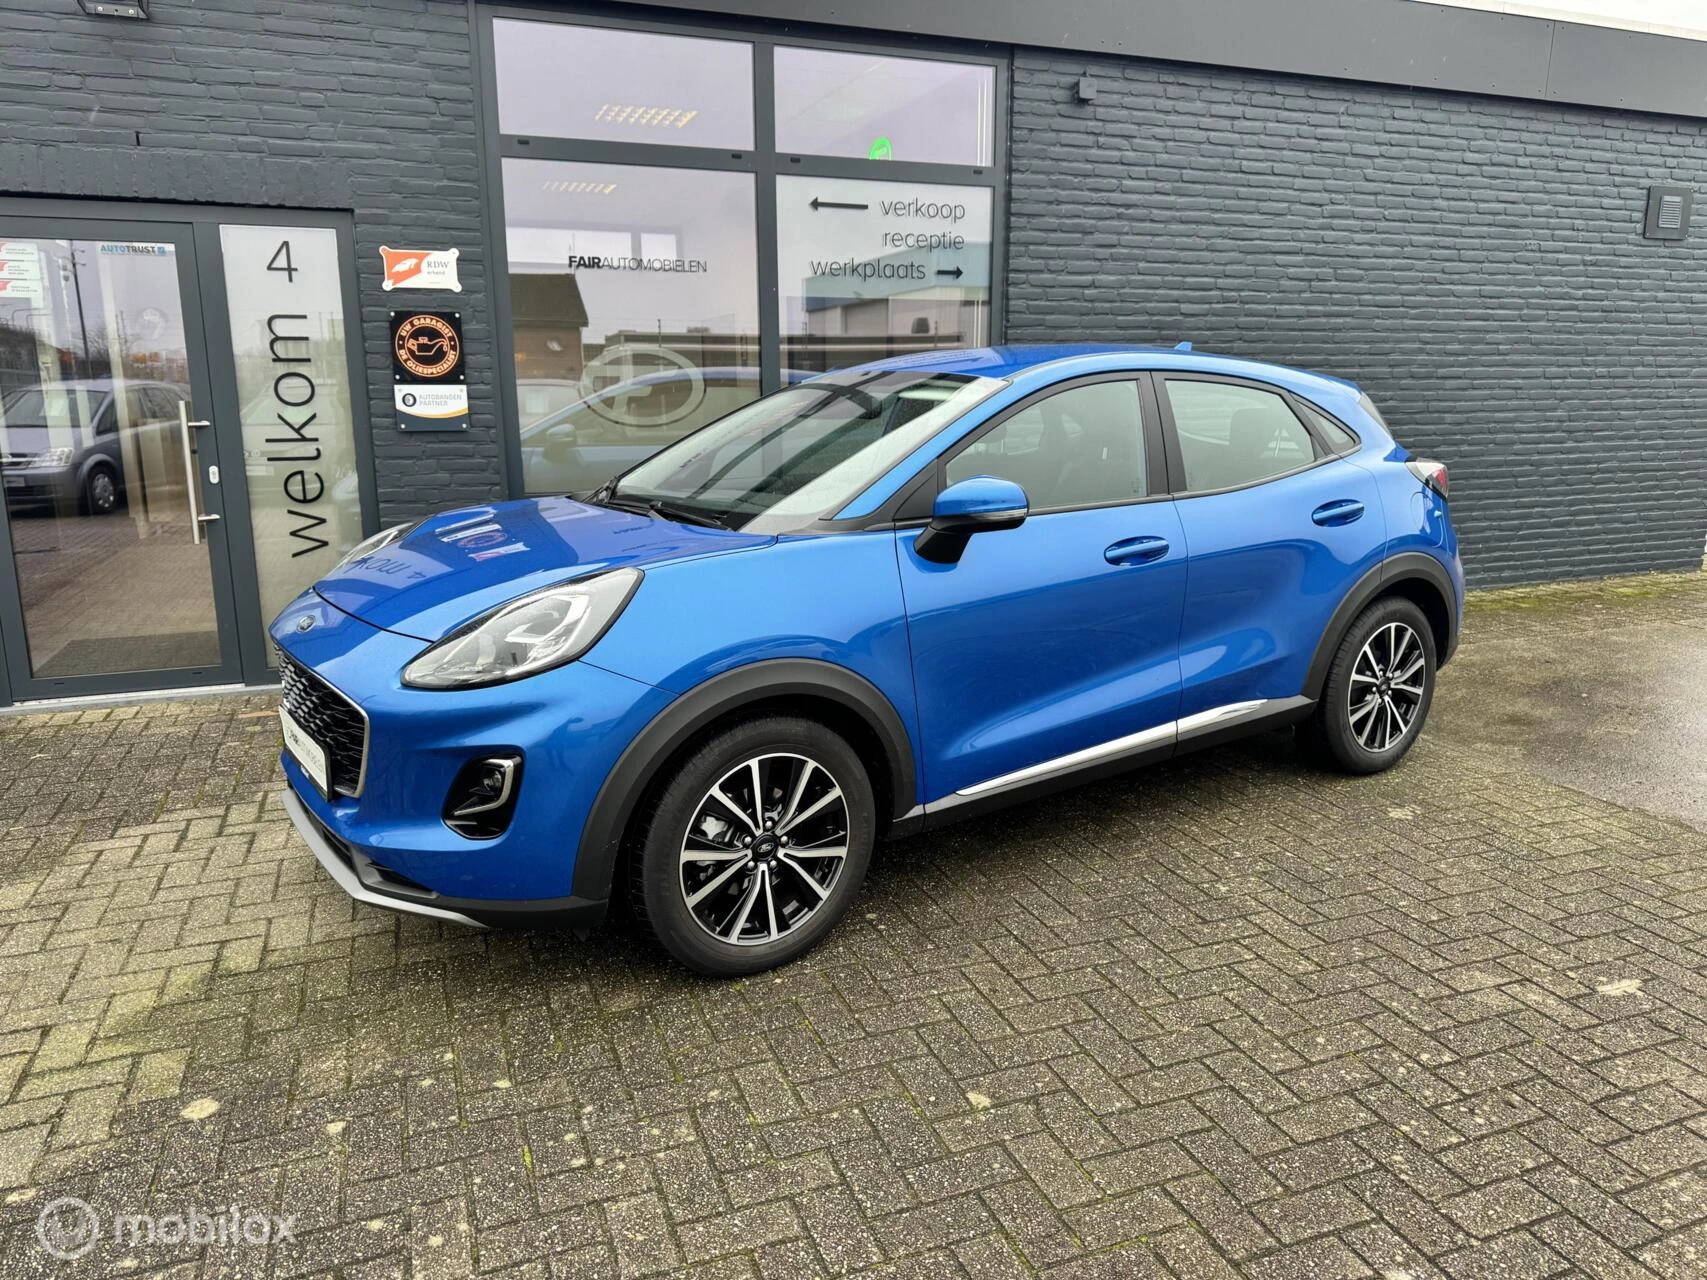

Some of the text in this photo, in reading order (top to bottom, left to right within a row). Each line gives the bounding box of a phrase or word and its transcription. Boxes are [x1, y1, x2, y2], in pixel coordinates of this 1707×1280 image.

[880, 197, 966, 224] verkoop
[100, 243, 156, 255] AUTOTRUST
[881, 231, 965, 253] receptie
[426, 260, 450, 269] RDW
[567, 255, 708, 273] FAIRAUTOMOBIELEN
[810, 256, 927, 282] werkplaats
[400, 317, 453, 337] UW GARAGIST
[399, 349, 457, 374] DE OLIESPECIALIST
[265, 240, 329, 558] welkom 4
